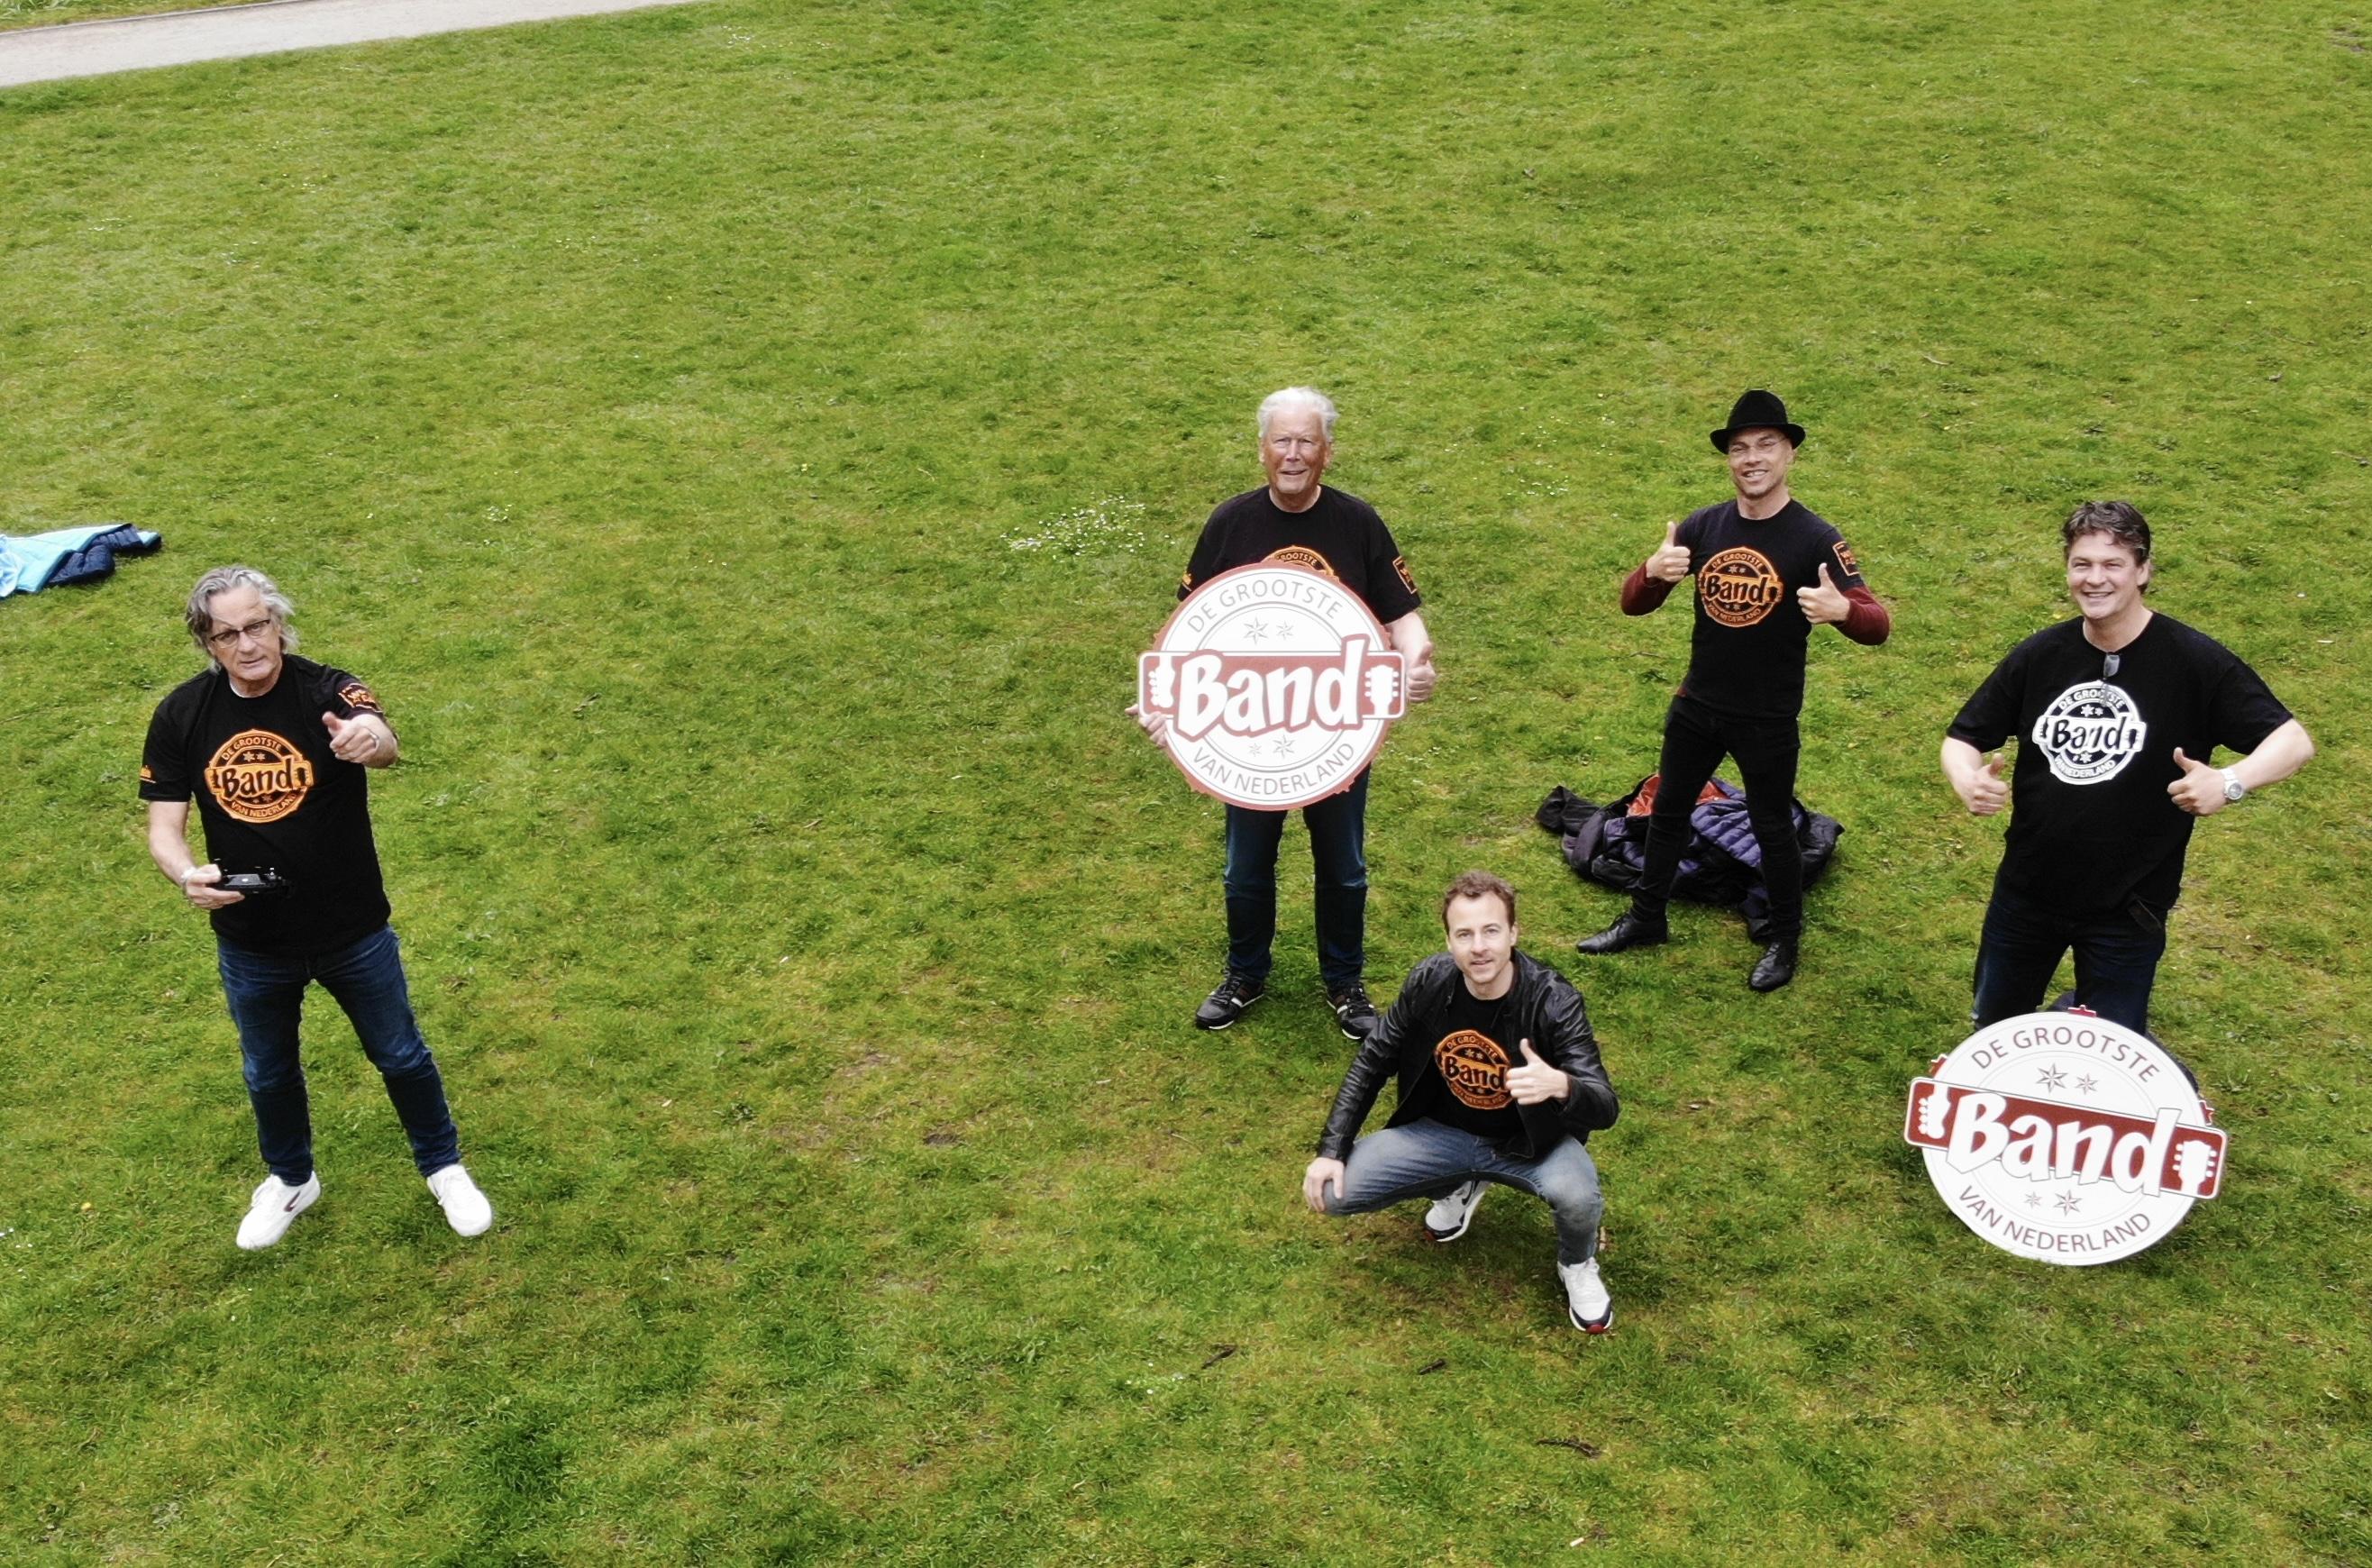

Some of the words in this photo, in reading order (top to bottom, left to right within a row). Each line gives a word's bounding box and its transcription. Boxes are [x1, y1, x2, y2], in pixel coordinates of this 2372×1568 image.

[1277, 552, 1318, 566] ROOTSTE
[1187, 602, 1218, 634] DE
[1219, 579, 1344, 620] GROOTSTE
[1705, 574, 1768, 604] Band
[1174, 634, 1369, 740] Band
[2057, 697, 2074, 711] DE
[2074, 688, 2126, 709] GROSTE
[221, 749, 234, 761] DE
[233, 736, 282, 752] GROOTSTE
[2052, 716, 2127, 750] Band
[221, 758, 293, 798] Band
[1192, 746, 1232, 784] VAN
[1234, 743, 1355, 796] NEDERLAND
[231, 800, 249, 816] VAN
[249, 793, 297, 817] NEDERLAND
[1444, 1055, 1506, 1089] Band
[1971, 1039, 2008, 1070] DE
[2012, 1026, 2160, 1082] GROOTSTE
[1945, 1091, 2183, 1198] Band
[1959, 1185, 2004, 1229] VAN
[2003, 1212, 2151, 1253] NEDERLAND
